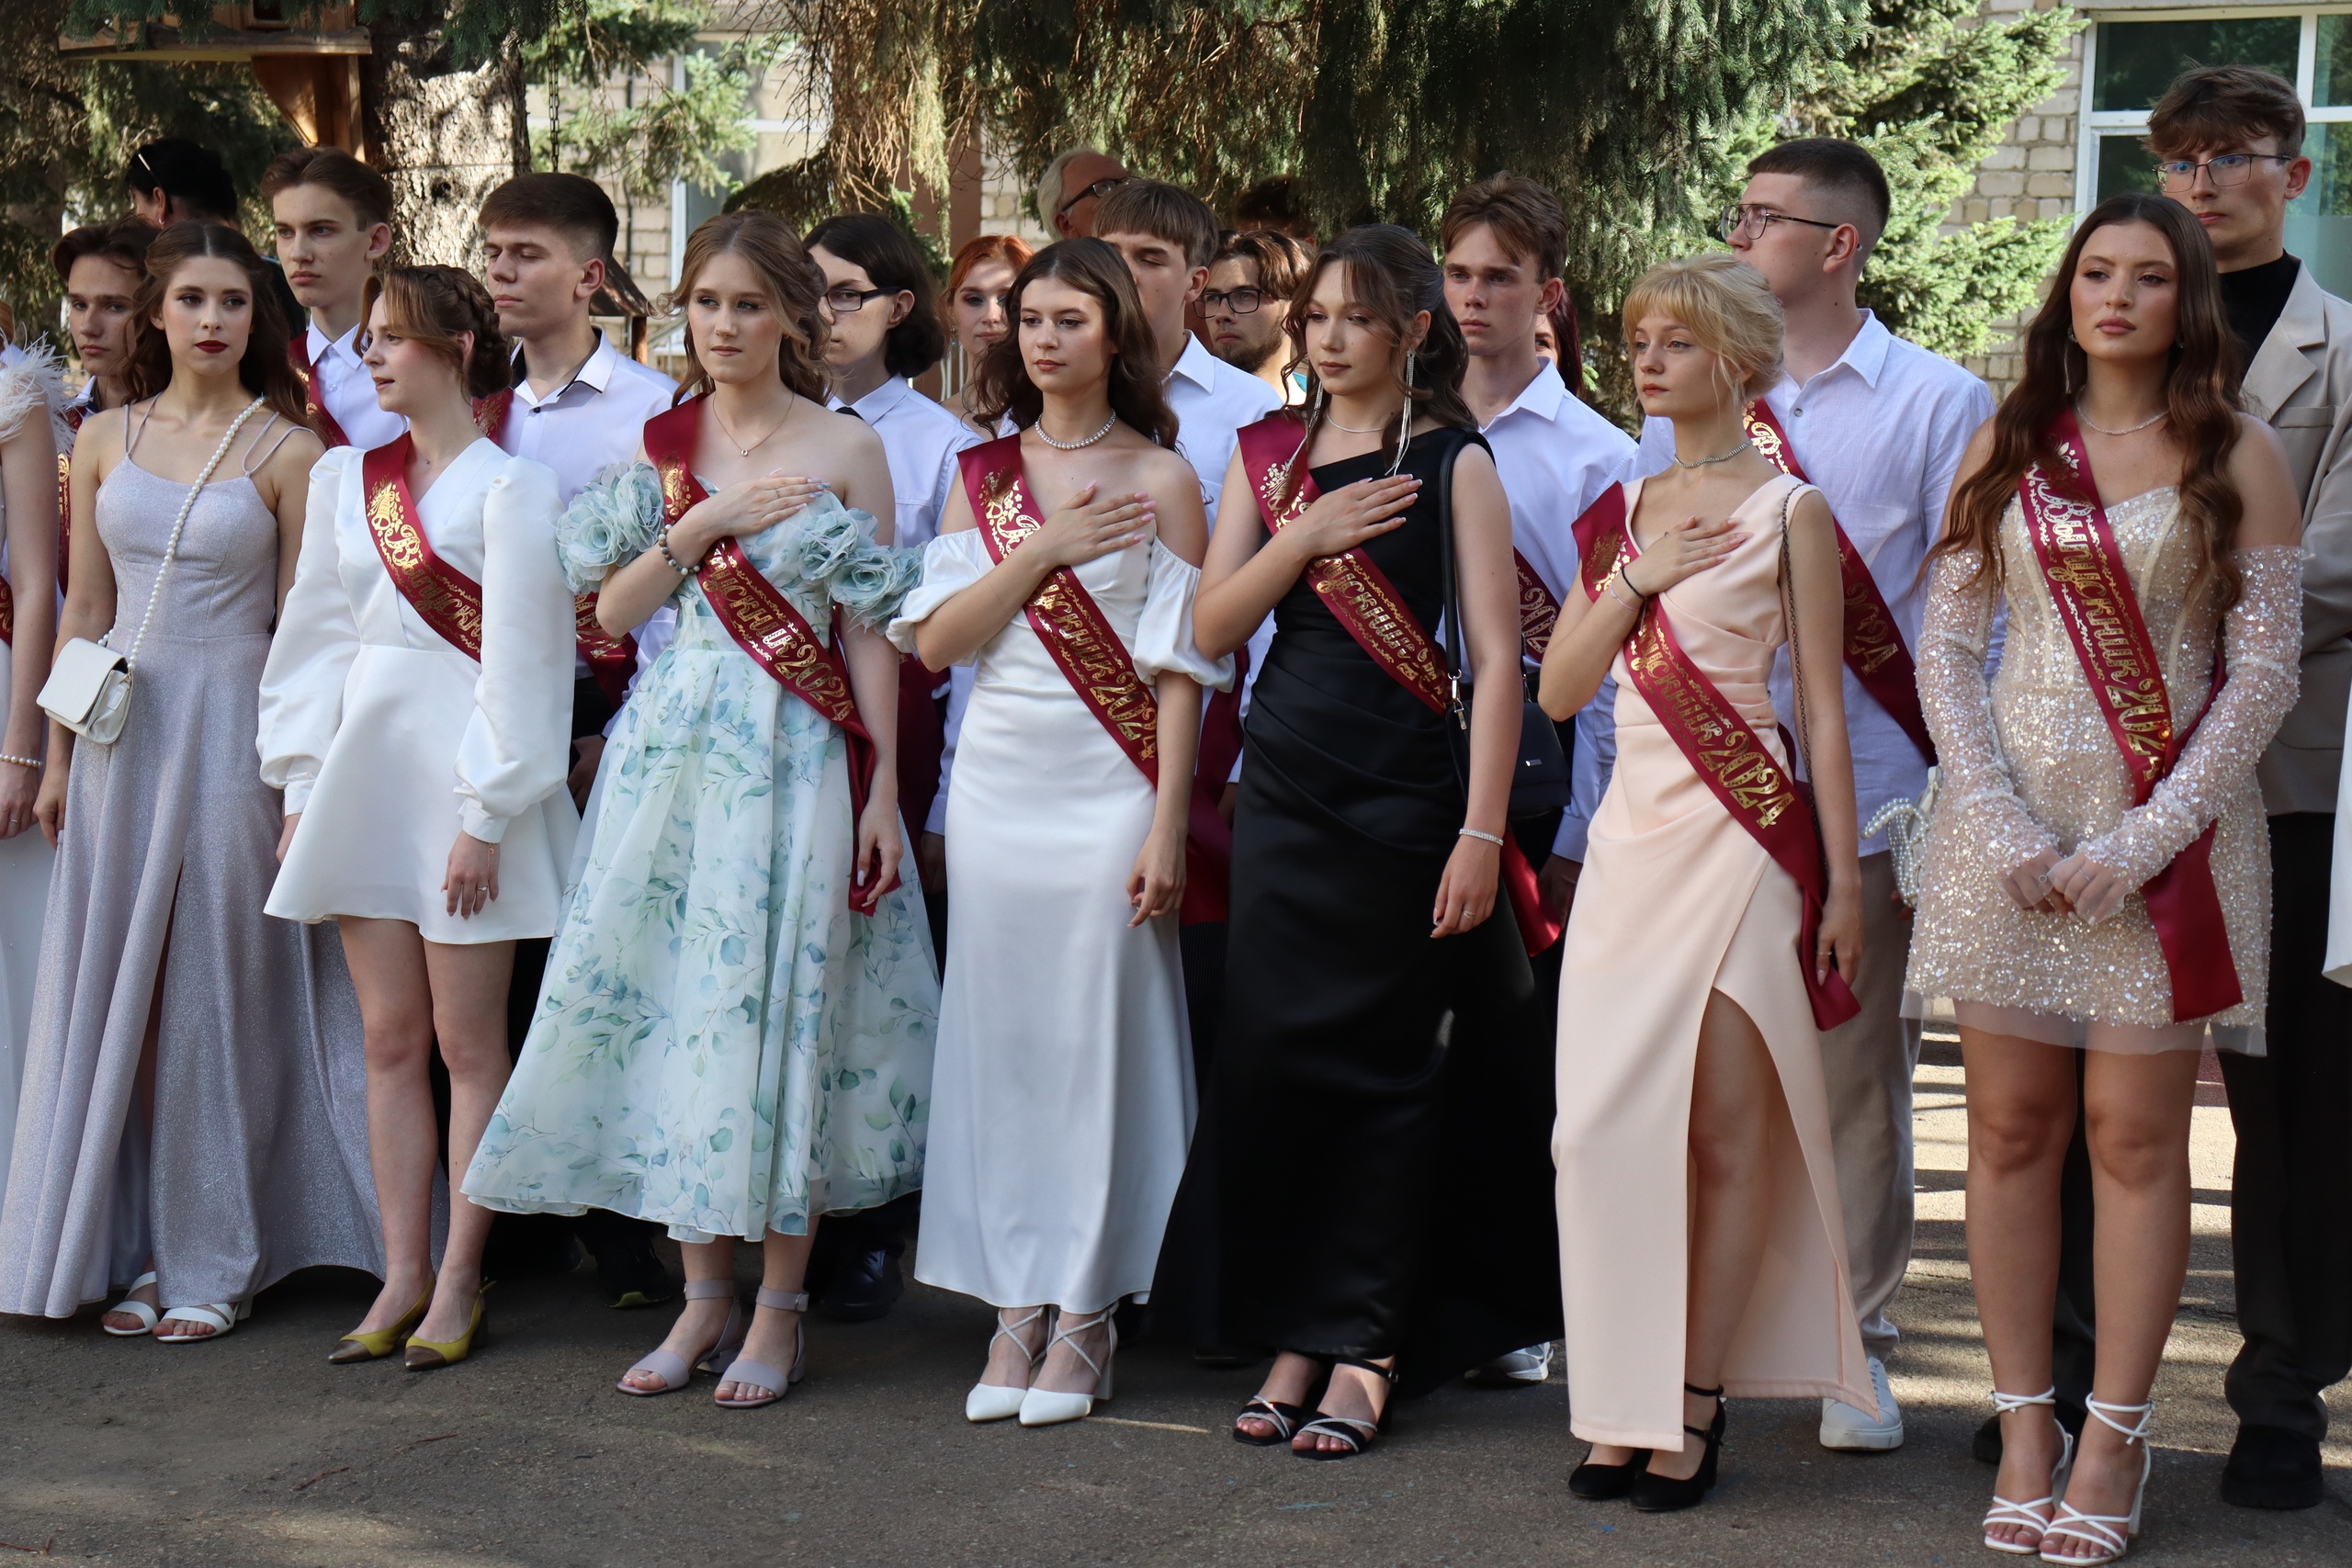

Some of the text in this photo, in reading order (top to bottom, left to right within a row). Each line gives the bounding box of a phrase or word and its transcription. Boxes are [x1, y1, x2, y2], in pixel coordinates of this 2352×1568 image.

[384, 525, 483, 643] Выпускн
[701, 547, 854, 722] пускник 2024
[2038, 482, 2141, 685] Выпускник
[1631, 624, 1795, 829] пускник 2024
